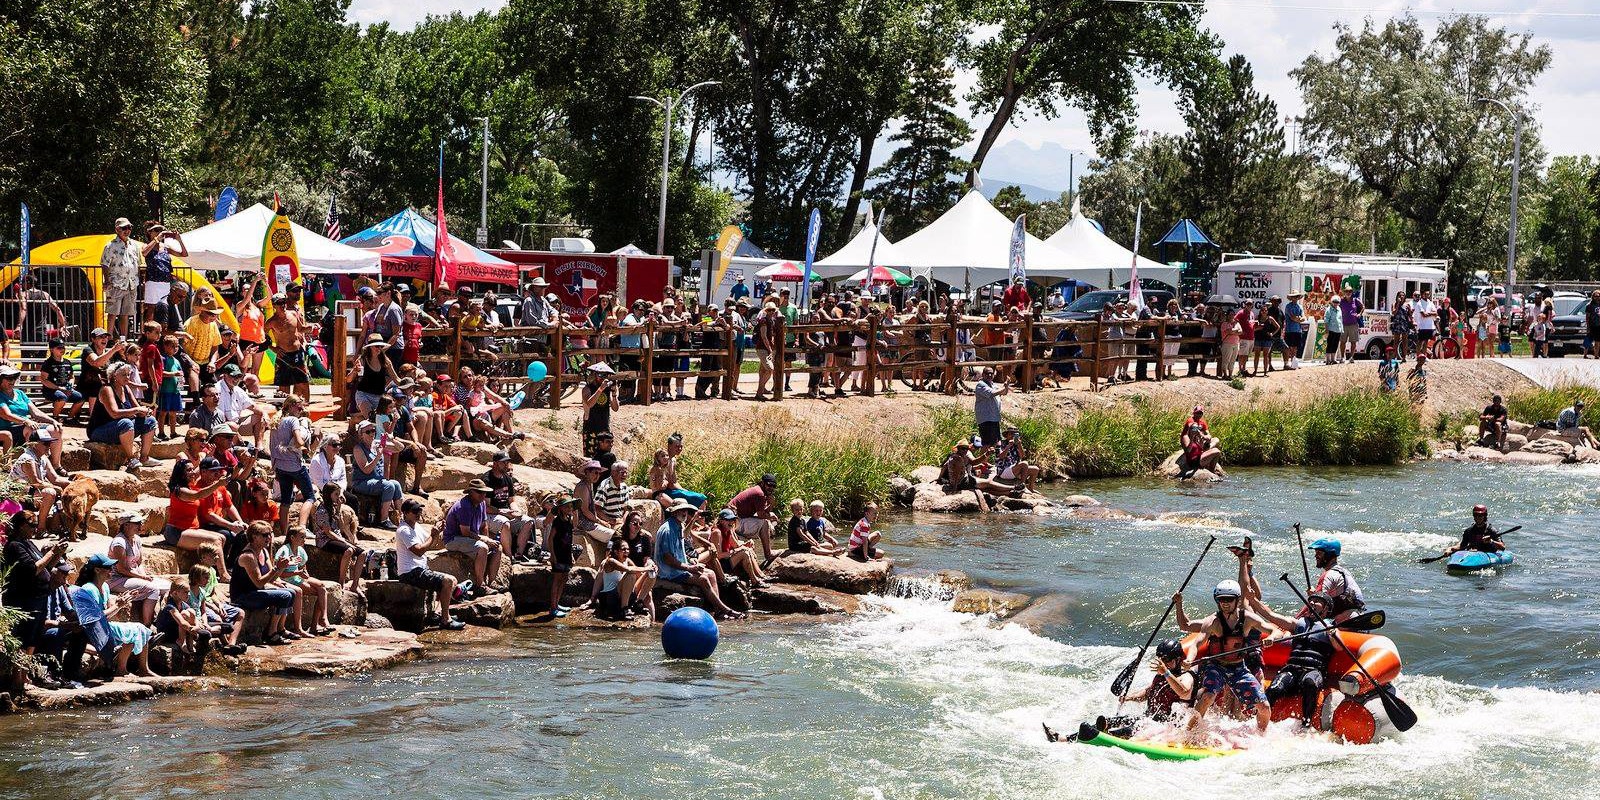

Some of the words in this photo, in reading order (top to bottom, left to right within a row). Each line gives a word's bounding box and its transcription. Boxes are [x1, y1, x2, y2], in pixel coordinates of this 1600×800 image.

[385, 261, 420, 272] PADDLE
[555, 261, 576, 276] BLUE
[1234, 279, 1272, 288] MAKIN'
[1238, 290, 1267, 299] SOME
